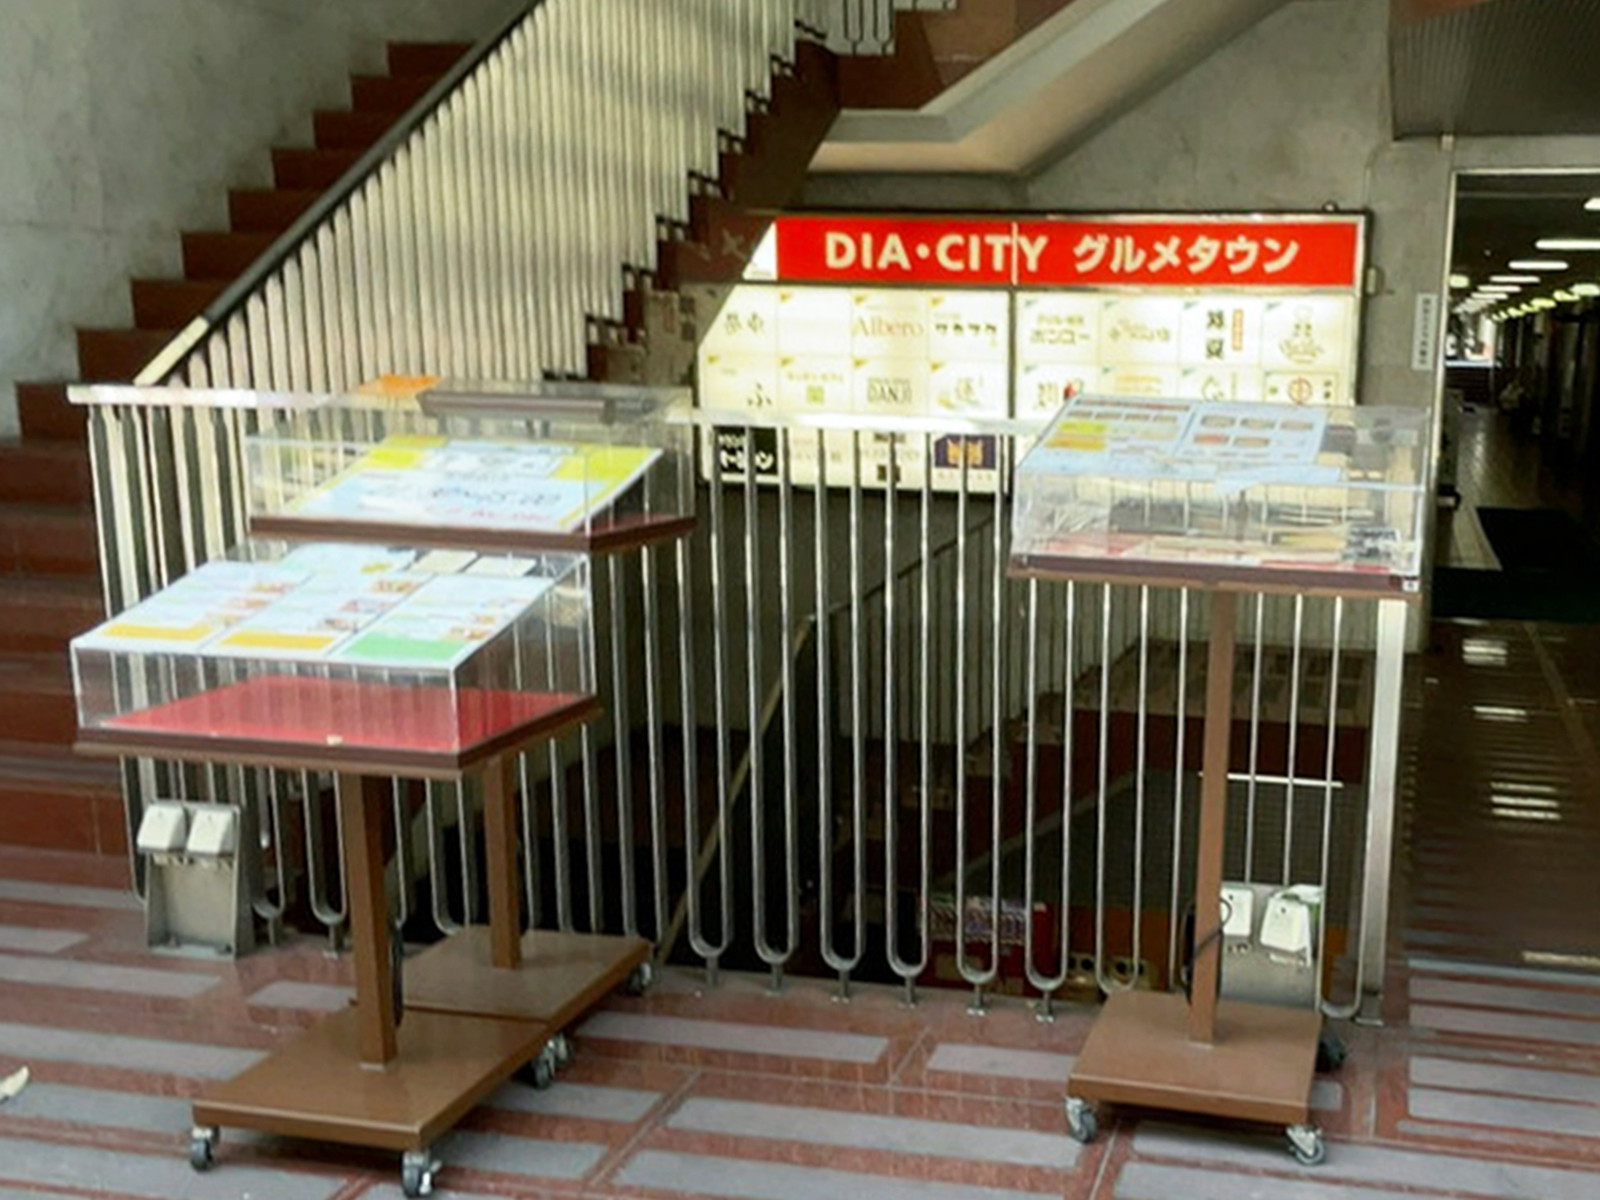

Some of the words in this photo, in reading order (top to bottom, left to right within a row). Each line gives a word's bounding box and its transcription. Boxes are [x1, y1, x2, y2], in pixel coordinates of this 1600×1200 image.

[1073, 234, 1299, 274] グルメタウン
[852, 315, 924, 337] Albero
